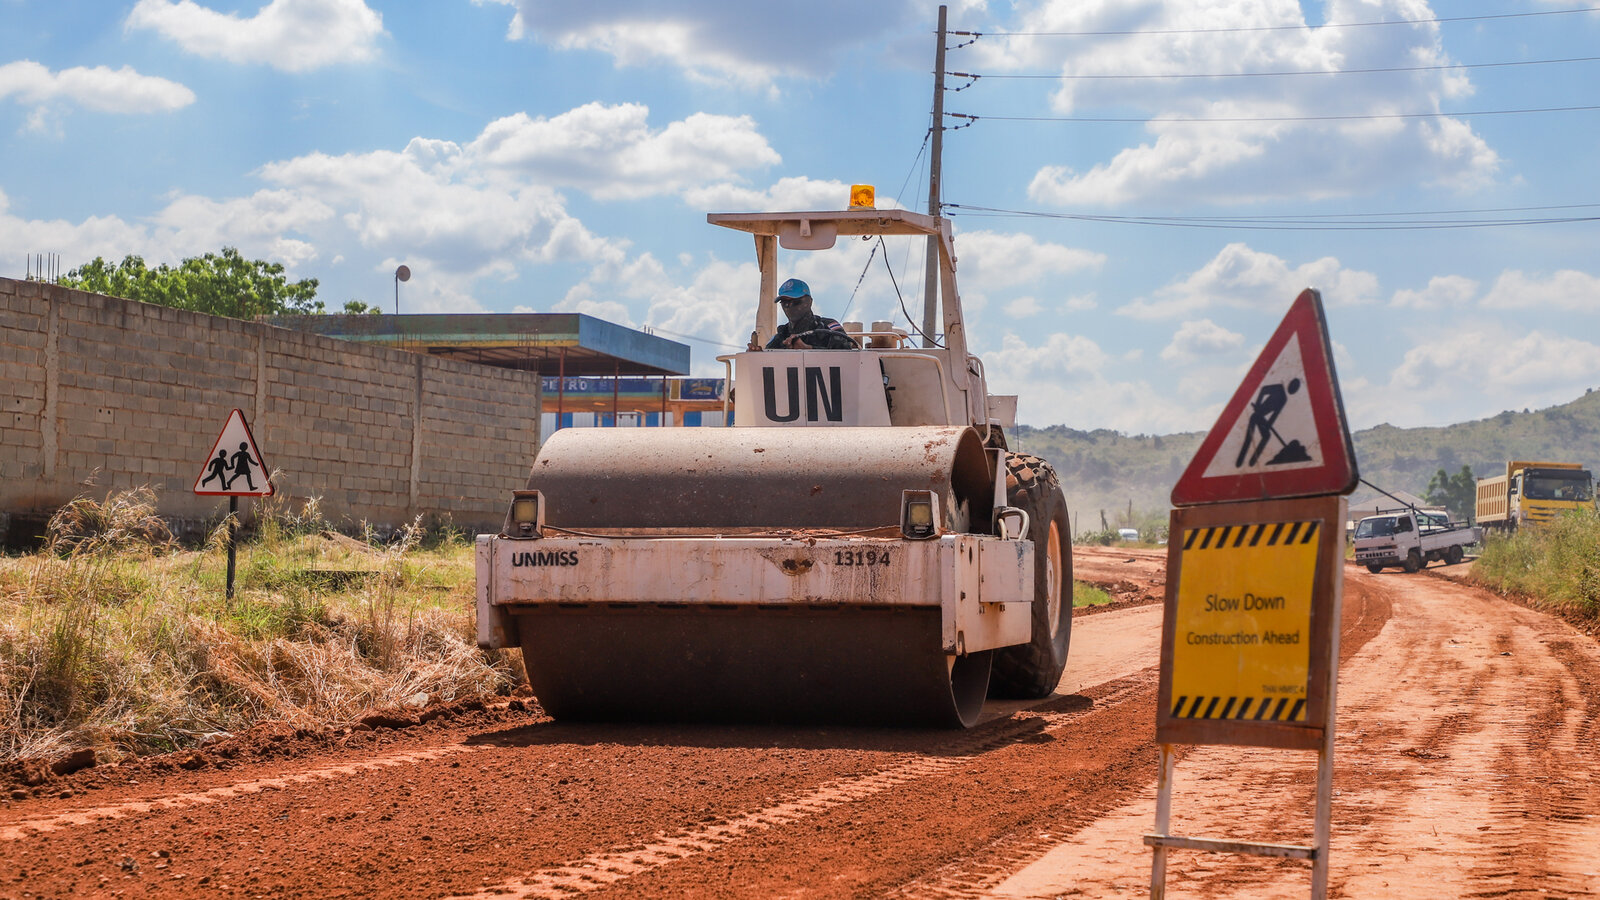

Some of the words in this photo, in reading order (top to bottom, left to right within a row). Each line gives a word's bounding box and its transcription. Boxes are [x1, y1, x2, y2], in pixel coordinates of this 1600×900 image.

[762, 366, 843, 422] UN
[512, 551, 579, 567] UNMISS
[834, 551, 891, 567] 13194
[1205, 594, 1240, 612] Slow
[1244, 593, 1285, 611] Down
[1186, 631, 1258, 645] Construction
[1262, 630, 1300, 644] Ahead
